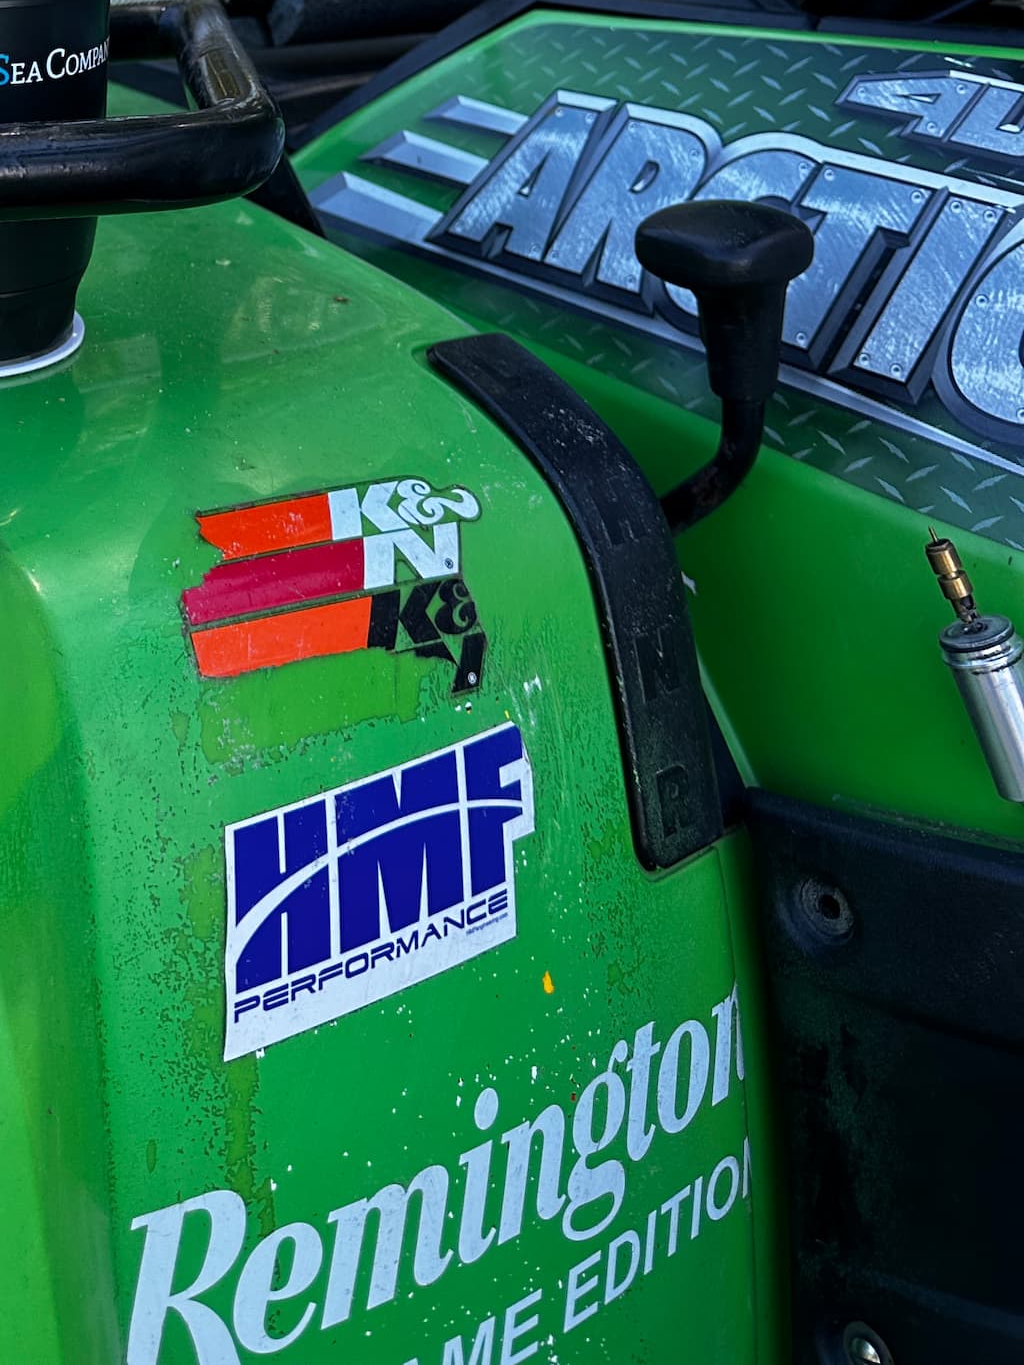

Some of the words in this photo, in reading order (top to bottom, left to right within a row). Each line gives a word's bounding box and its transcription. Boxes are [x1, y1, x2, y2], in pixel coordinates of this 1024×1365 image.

[233, 724, 524, 995] HMF
[654, 763, 689, 837] R
[233, 887, 509, 1024] PERFORMANCE
[126, 980, 745, 1365] Remington
